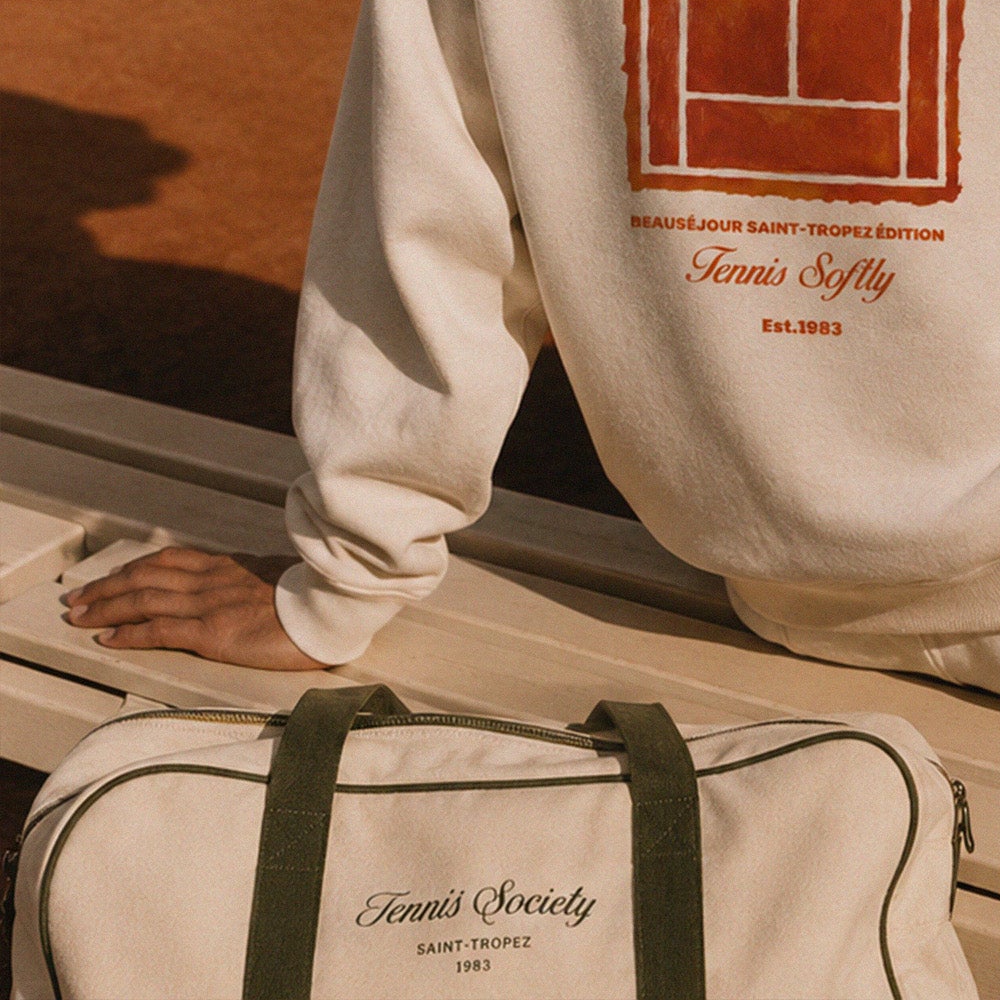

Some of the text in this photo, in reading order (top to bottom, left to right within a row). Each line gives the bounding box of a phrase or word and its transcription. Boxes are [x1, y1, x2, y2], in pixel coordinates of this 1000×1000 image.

[630, 214, 945, 242] BEAUSÉJOUR SAINT-TROPEZ ÉDITION
[685, 245, 896, 304] Tennis Softly
[762, 318, 843, 336] Est.1983
[355, 878, 597, 928] Tennis Society
[416, 935, 532, 956] SAINT-TROPEZ
[456, 958, 492, 974] 1983
